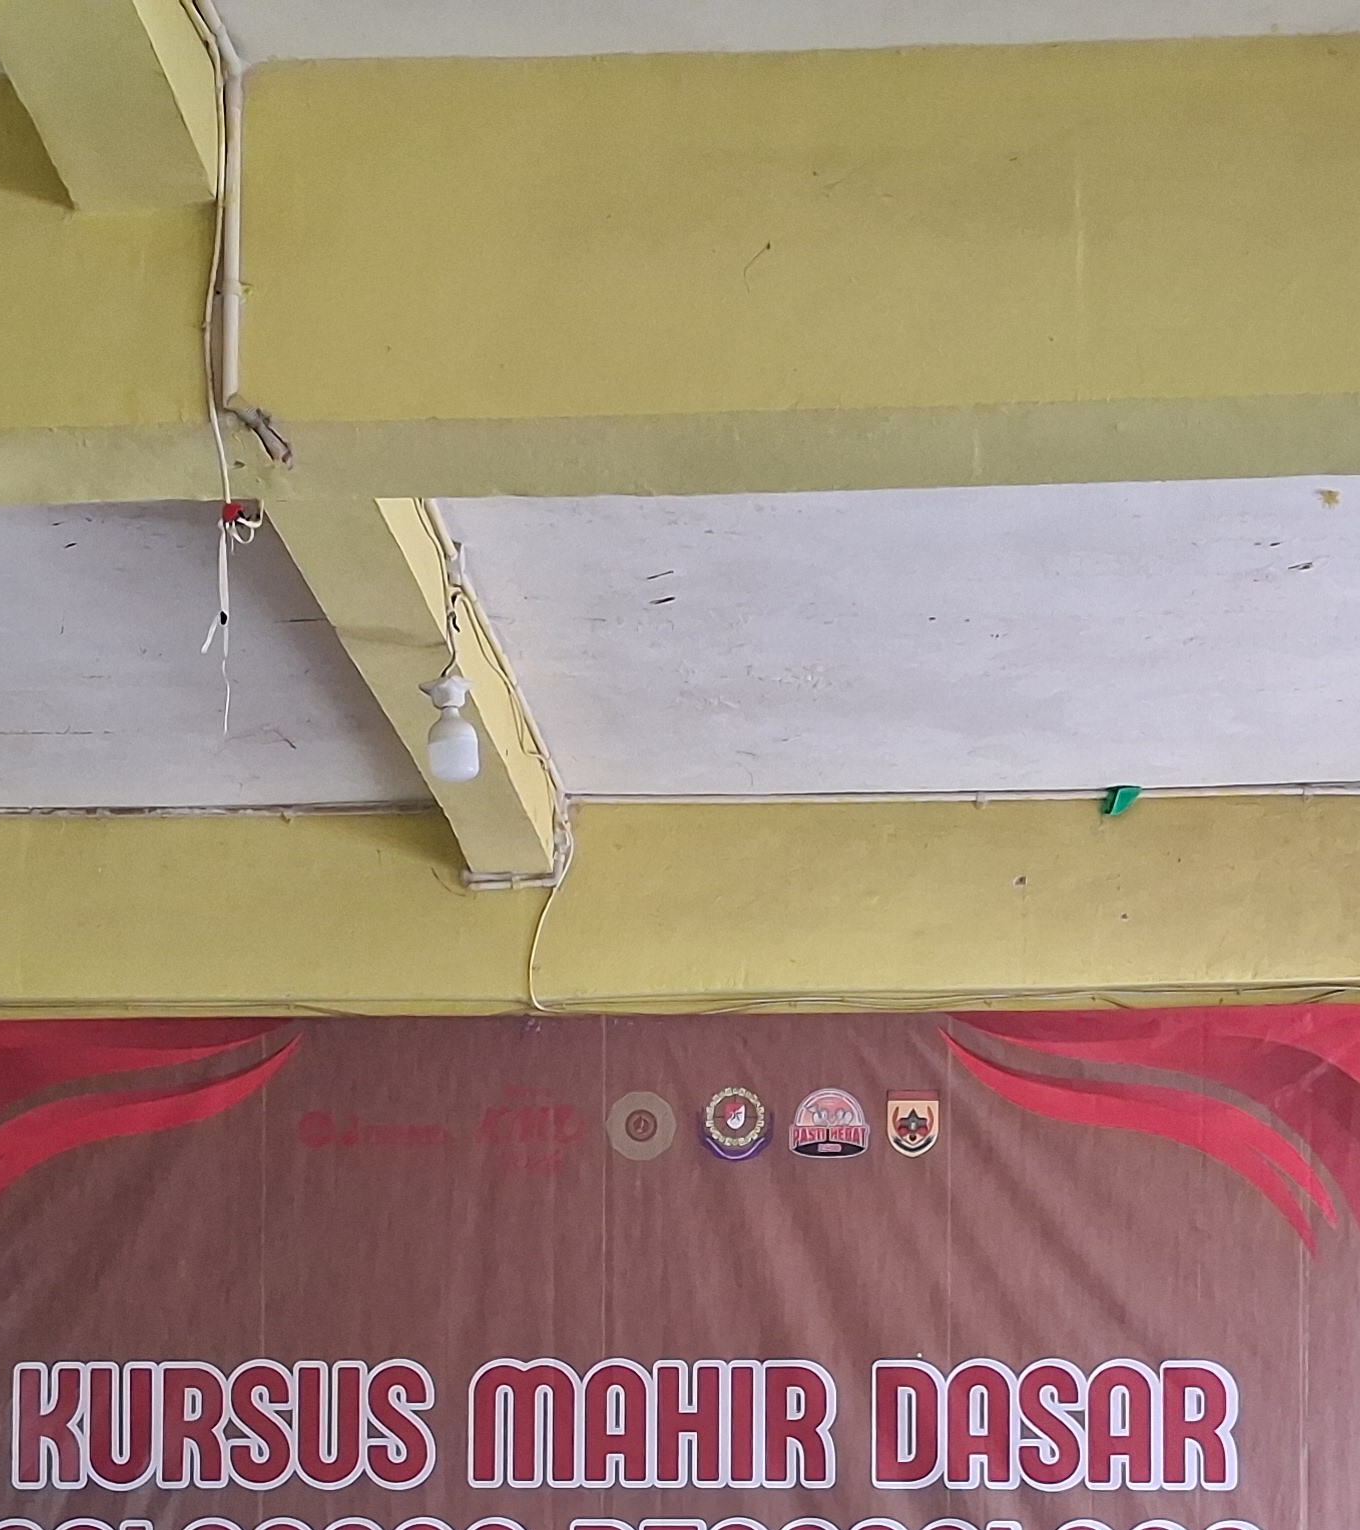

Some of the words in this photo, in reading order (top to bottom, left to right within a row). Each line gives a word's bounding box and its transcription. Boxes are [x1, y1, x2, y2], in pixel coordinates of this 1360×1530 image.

[12, 1358, 436, 1491] KURSUS
[468, 1358, 837, 1490] MAHIR
[870, 1357, 1241, 1492] DASAR
